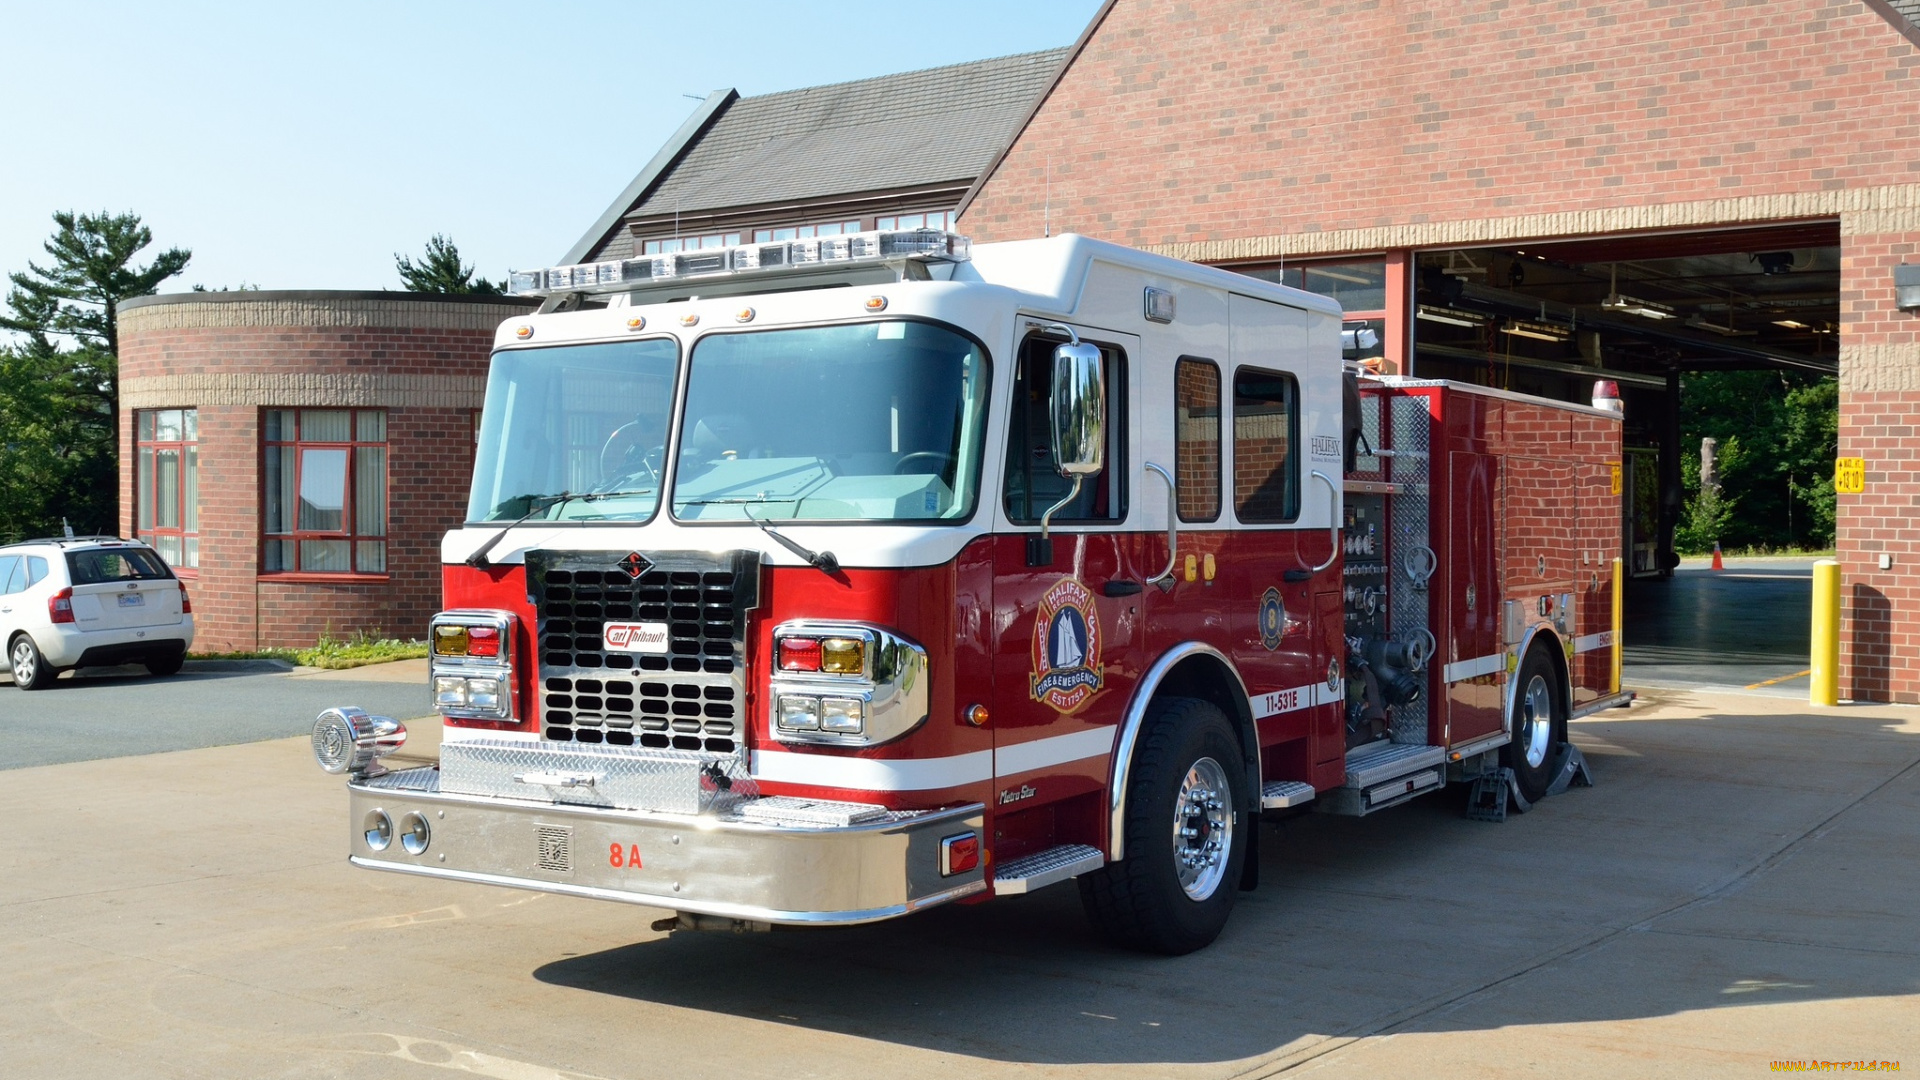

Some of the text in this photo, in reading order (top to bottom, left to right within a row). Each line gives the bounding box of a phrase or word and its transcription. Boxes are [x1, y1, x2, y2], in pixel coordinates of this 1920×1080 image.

[1311, 437, 1341, 456] HALIFAX
[1048, 582, 1087, 605] HALIFAX
[1053, 595, 1082, 611] REGIONAL
[1268, 608, 1276, 630] 8
[1266, 690, 1298, 713] 11-531E
